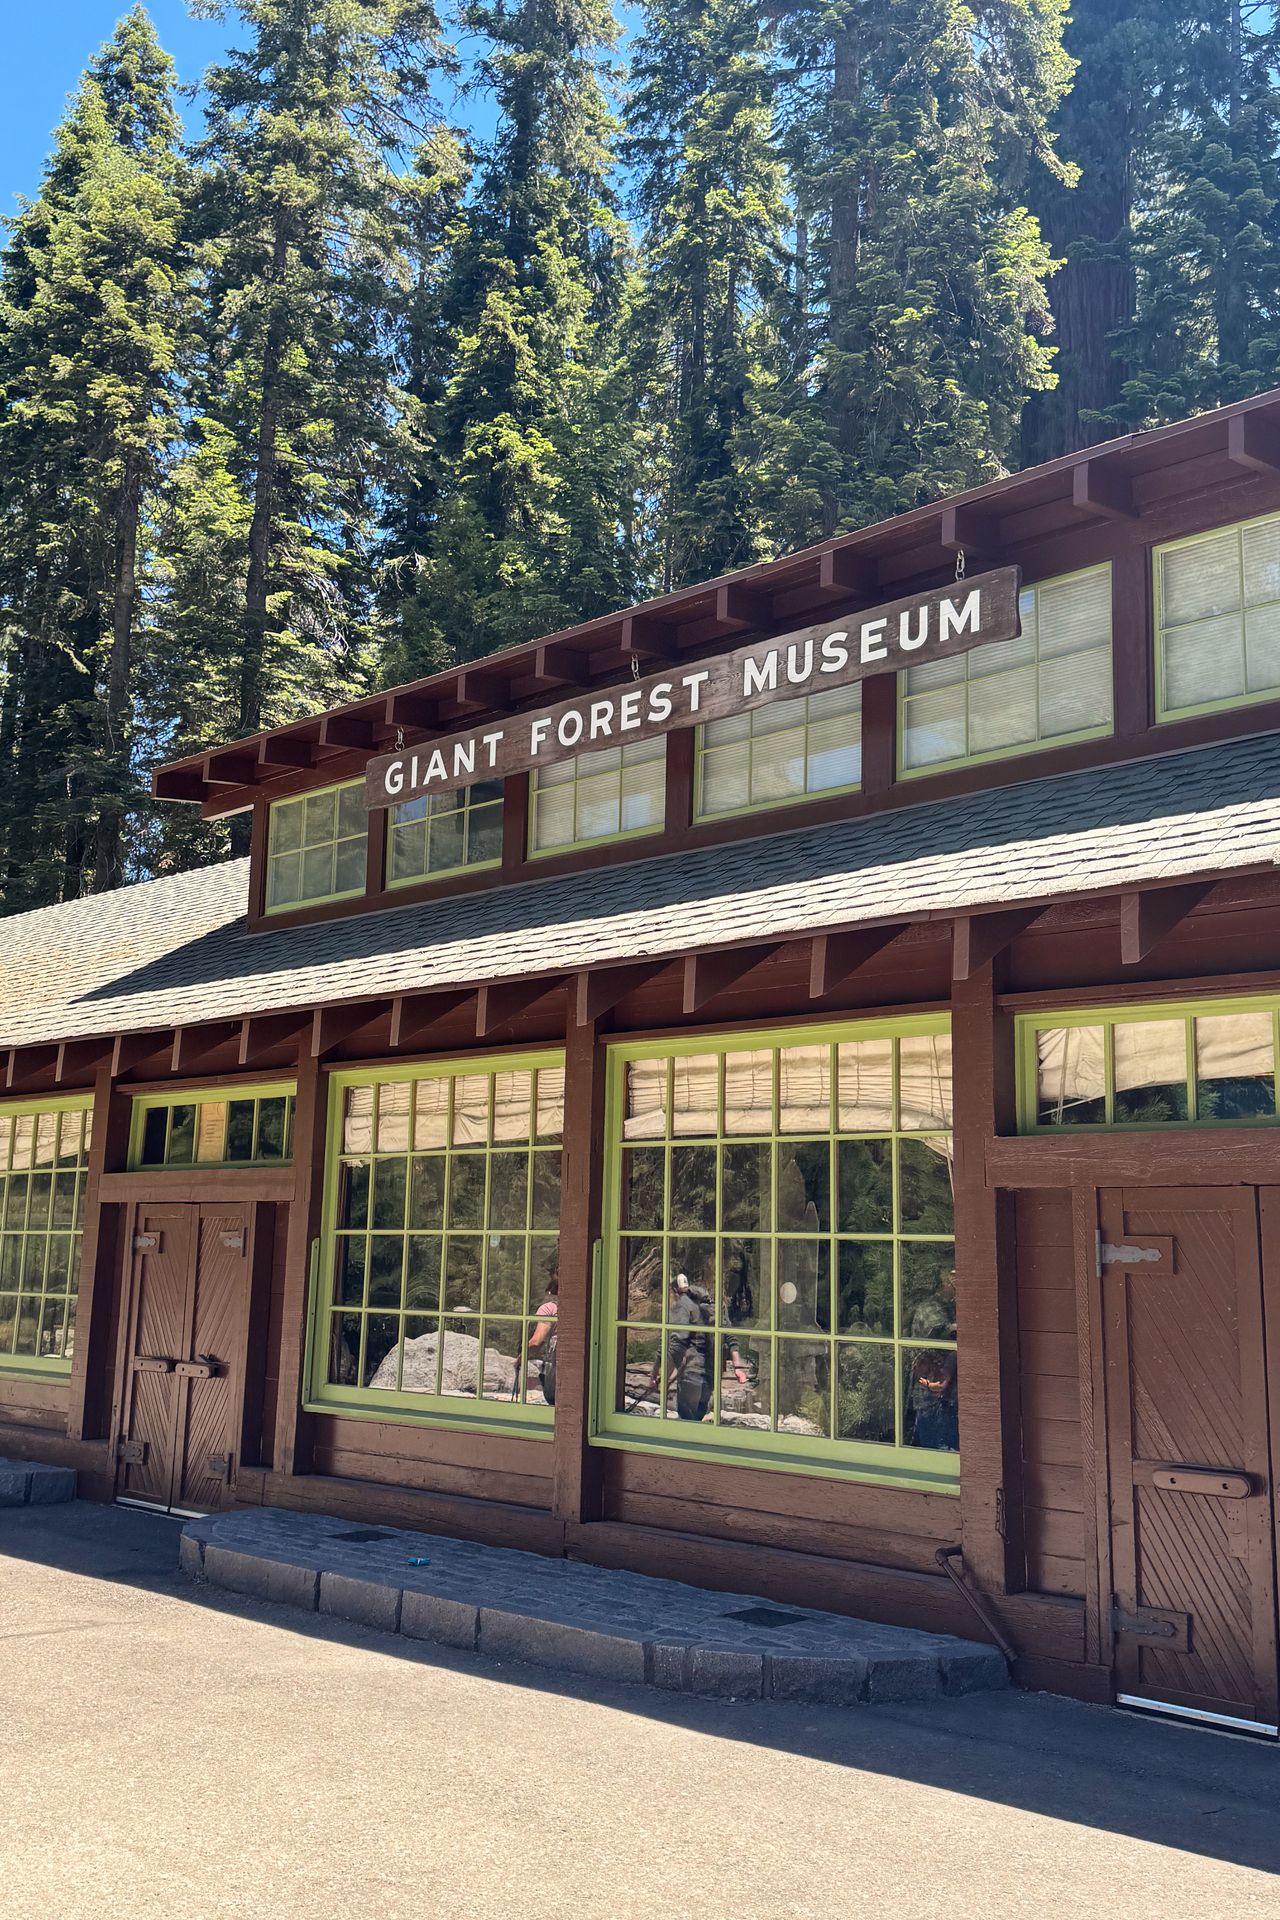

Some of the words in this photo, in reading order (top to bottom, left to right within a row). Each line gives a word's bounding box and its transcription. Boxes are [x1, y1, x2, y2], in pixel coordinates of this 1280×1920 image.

[384, 731, 504, 796] GIANT
[530, 671, 709, 756] FOREST
[743, 589, 981, 697] MUSEUM
